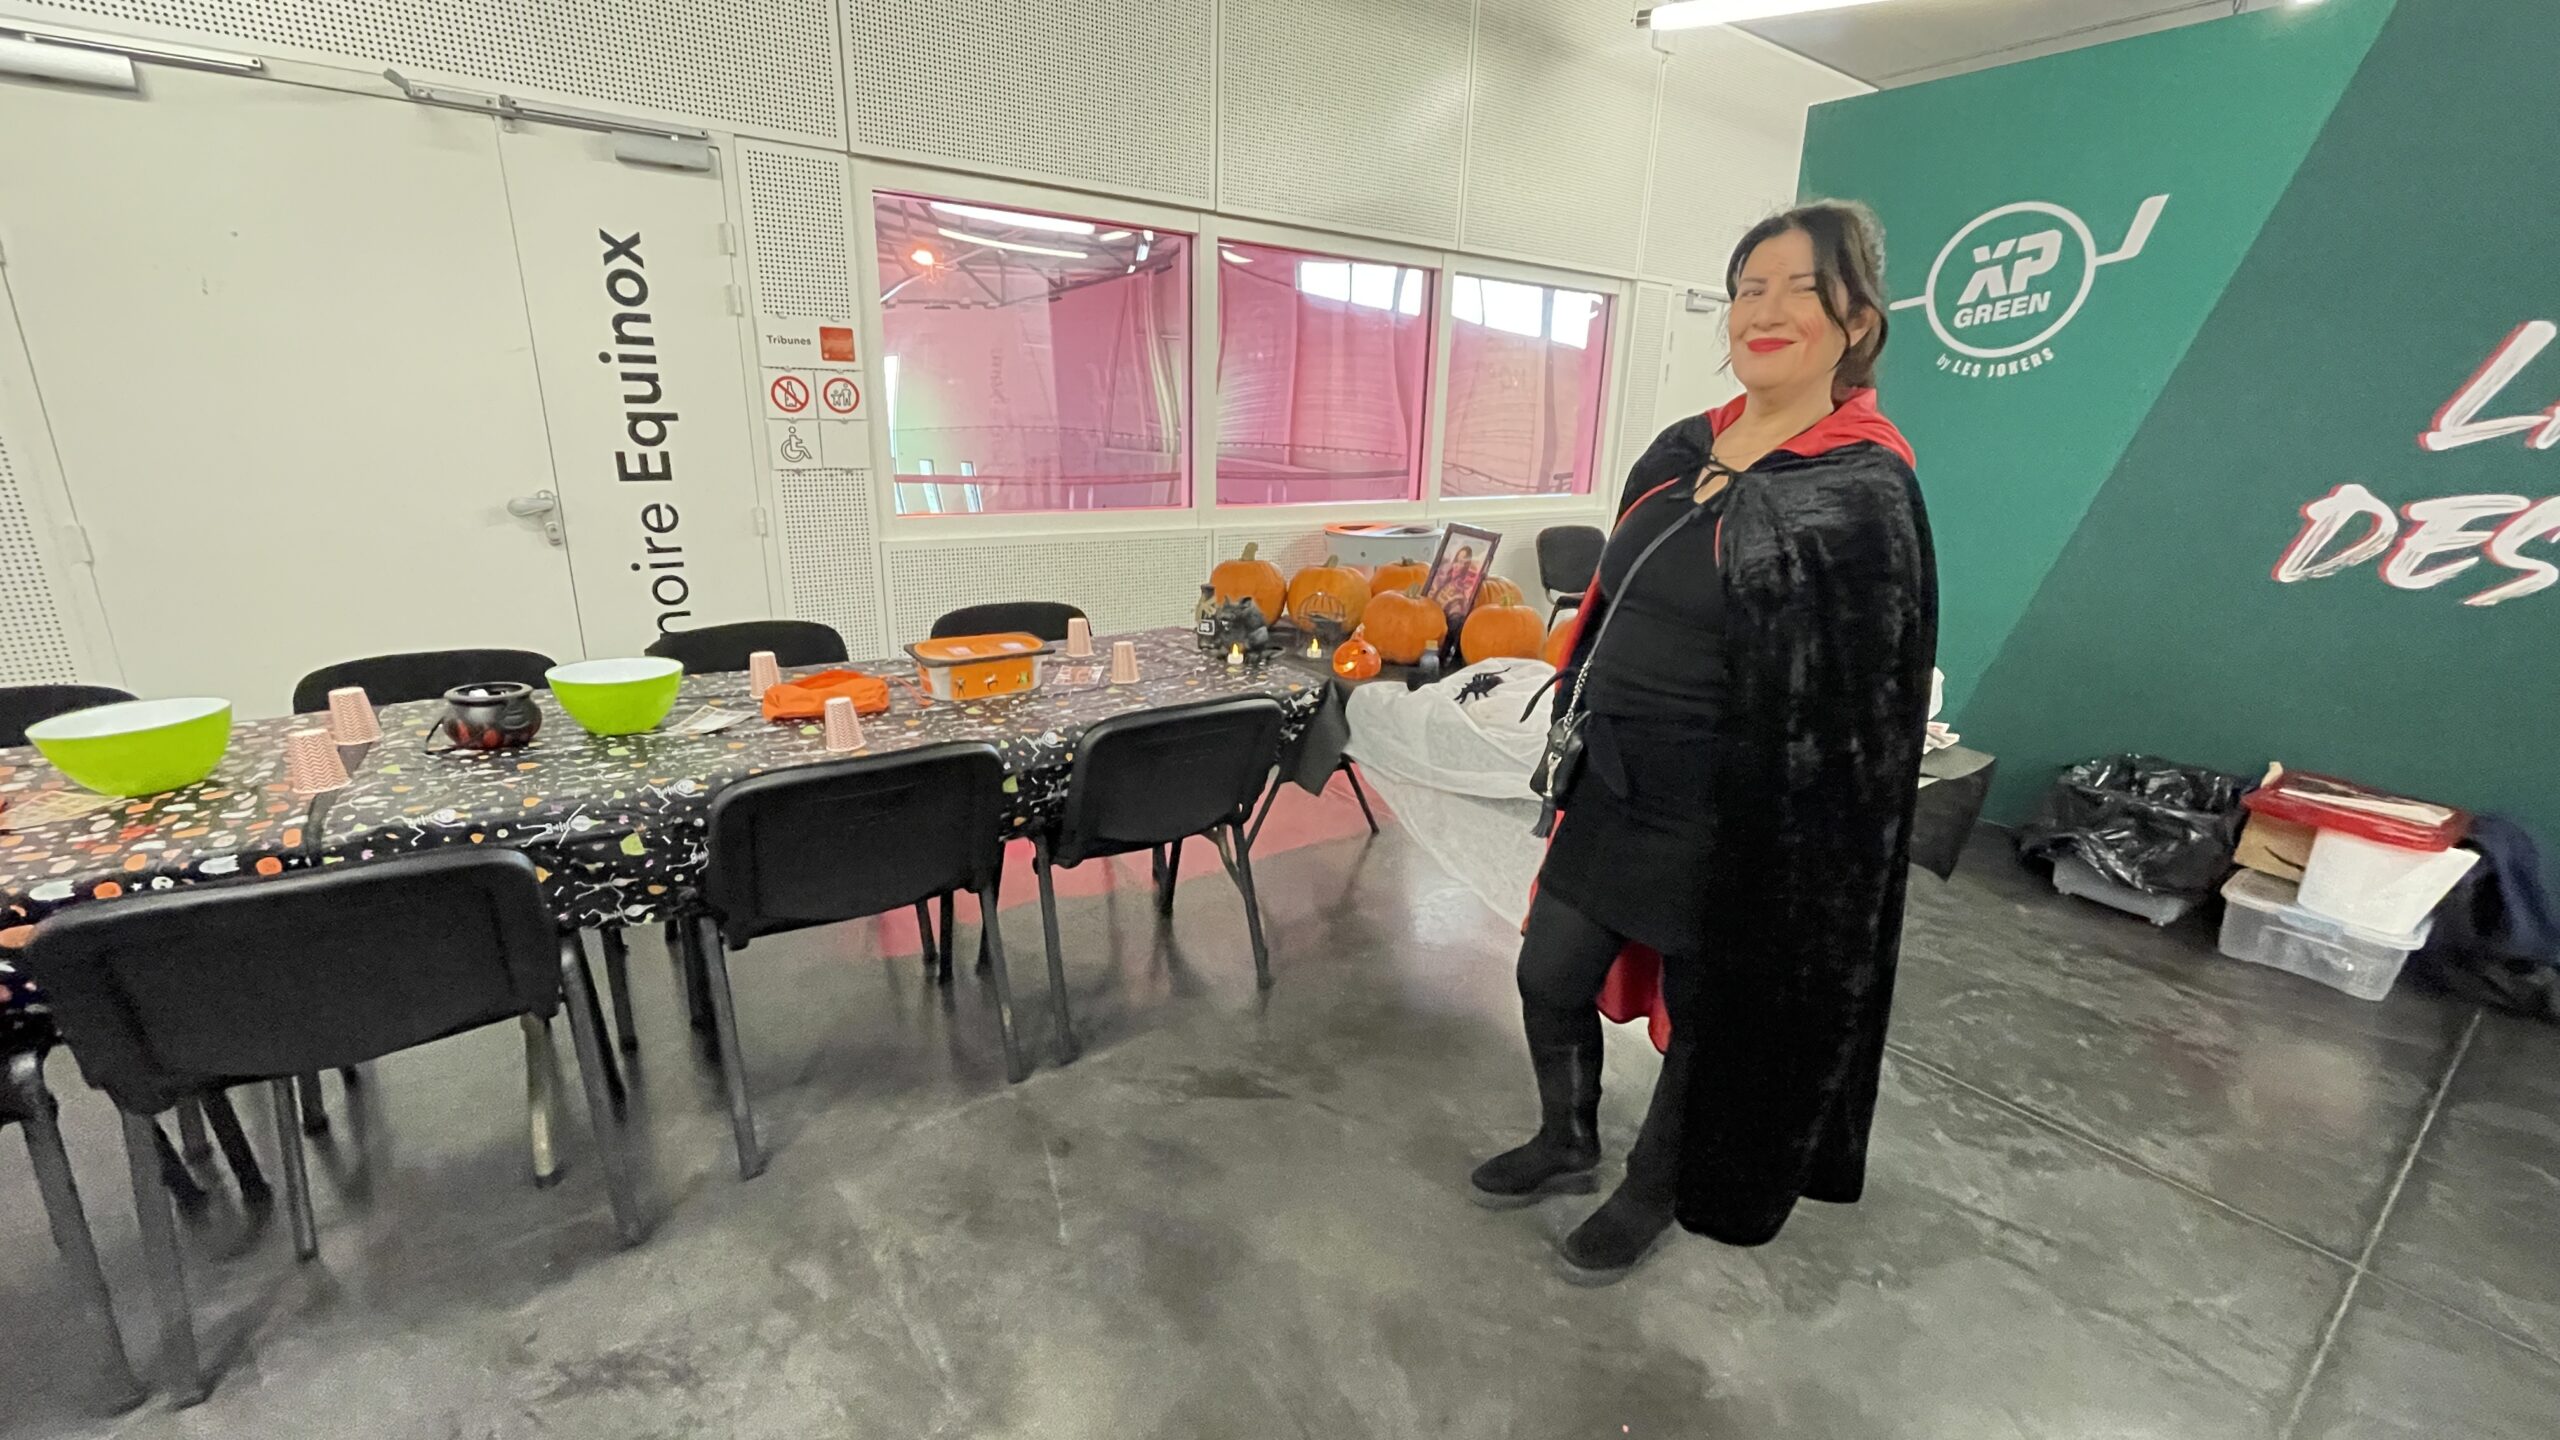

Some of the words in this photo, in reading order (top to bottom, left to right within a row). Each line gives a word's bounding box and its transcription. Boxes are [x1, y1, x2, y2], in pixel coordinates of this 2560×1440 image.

[1957, 229, 2063, 306] XP
[766, 334, 812, 346] Tribunes
[1953, 291, 2051, 329] GREEN
[598, 227, 679, 482] Equinox
[1936, 353, 1951, 371] by
[1951, 359, 1982, 378] LES
[1987, 347, 2055, 378] JOKERS
[2416, 320, 2560, 451] L
[2271, 483, 2560, 606] DES
